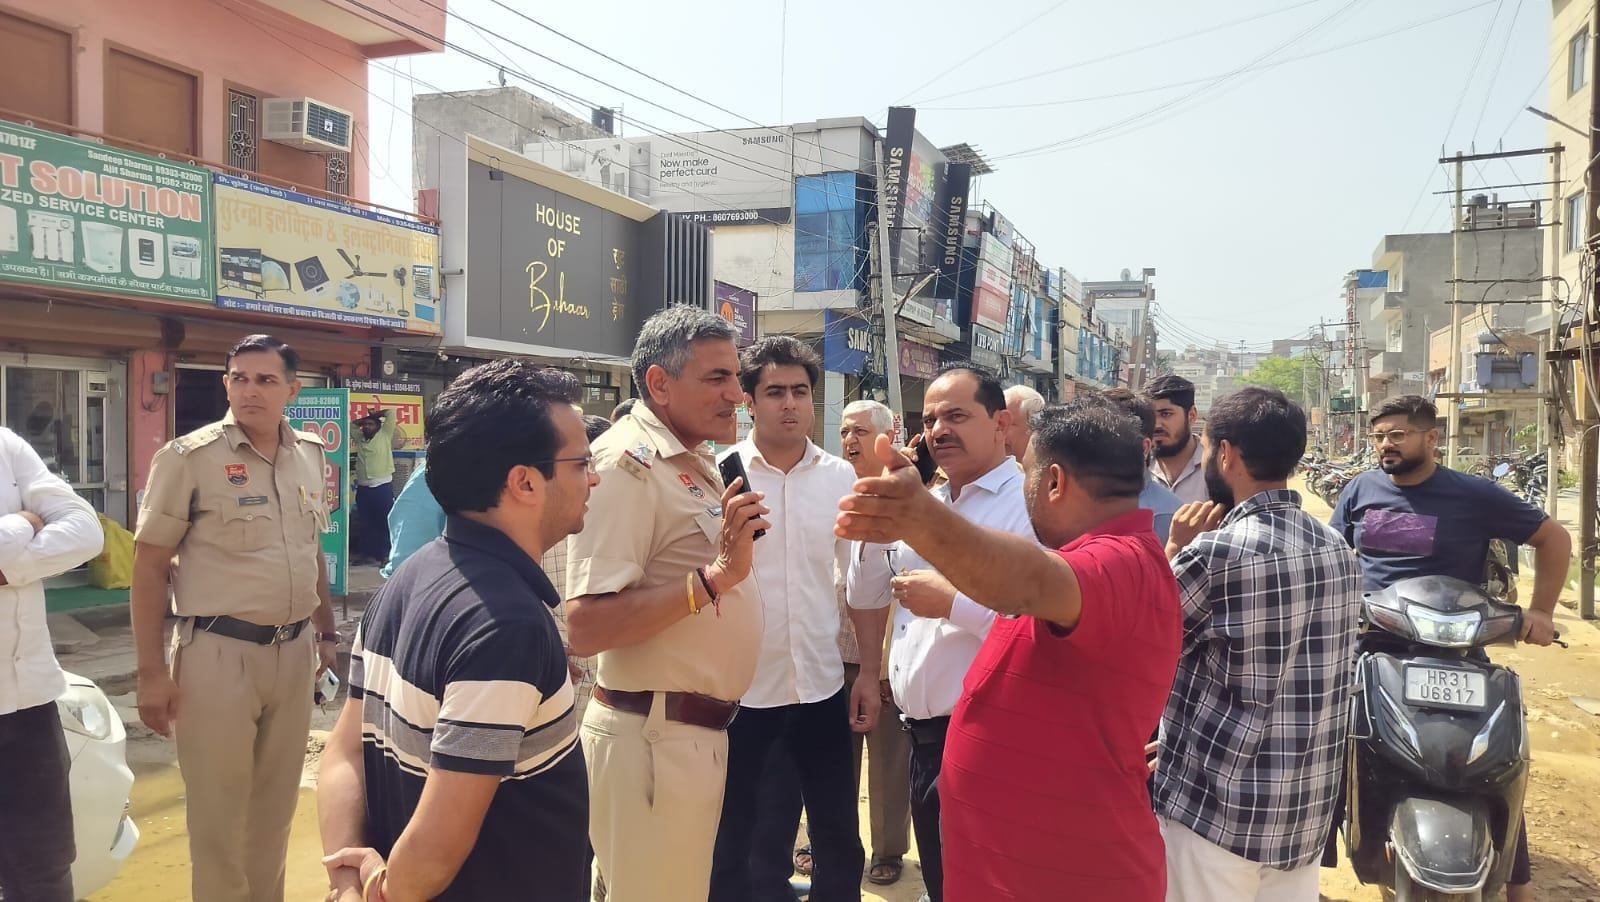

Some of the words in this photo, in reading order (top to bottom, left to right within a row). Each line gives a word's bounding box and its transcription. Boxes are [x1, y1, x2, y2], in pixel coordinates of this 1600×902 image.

[742, 134, 784, 146] SAMSUNG
[87, 150, 123, 166] Sandeep
[124, 157, 153, 173] Sharma
[660, 159, 681, 169] Now
[682, 157, 709, 167] make
[120, 167, 153, 182] Sharma
[660, 167, 694, 179] perfect
[695, 165, 718, 176] curd
[29, 159, 202, 223] SOLUTION
[1, 188, 34, 205] ZED
[39, 195, 105, 219] SERVICE
[109, 208, 165, 229] CENTER
[535, 202, 581, 235] HOUSE
[693, 213, 706, 222] PH
[712, 211, 759, 221] 8607693000
[944, 196, 962, 265] SAMSUNG
[547, 238, 566, 258] OF
[288, 406, 341, 420] SOLUTION
[1427, 669, 1469, 691] HR31
[1420, 684, 1475, 704] U6817
